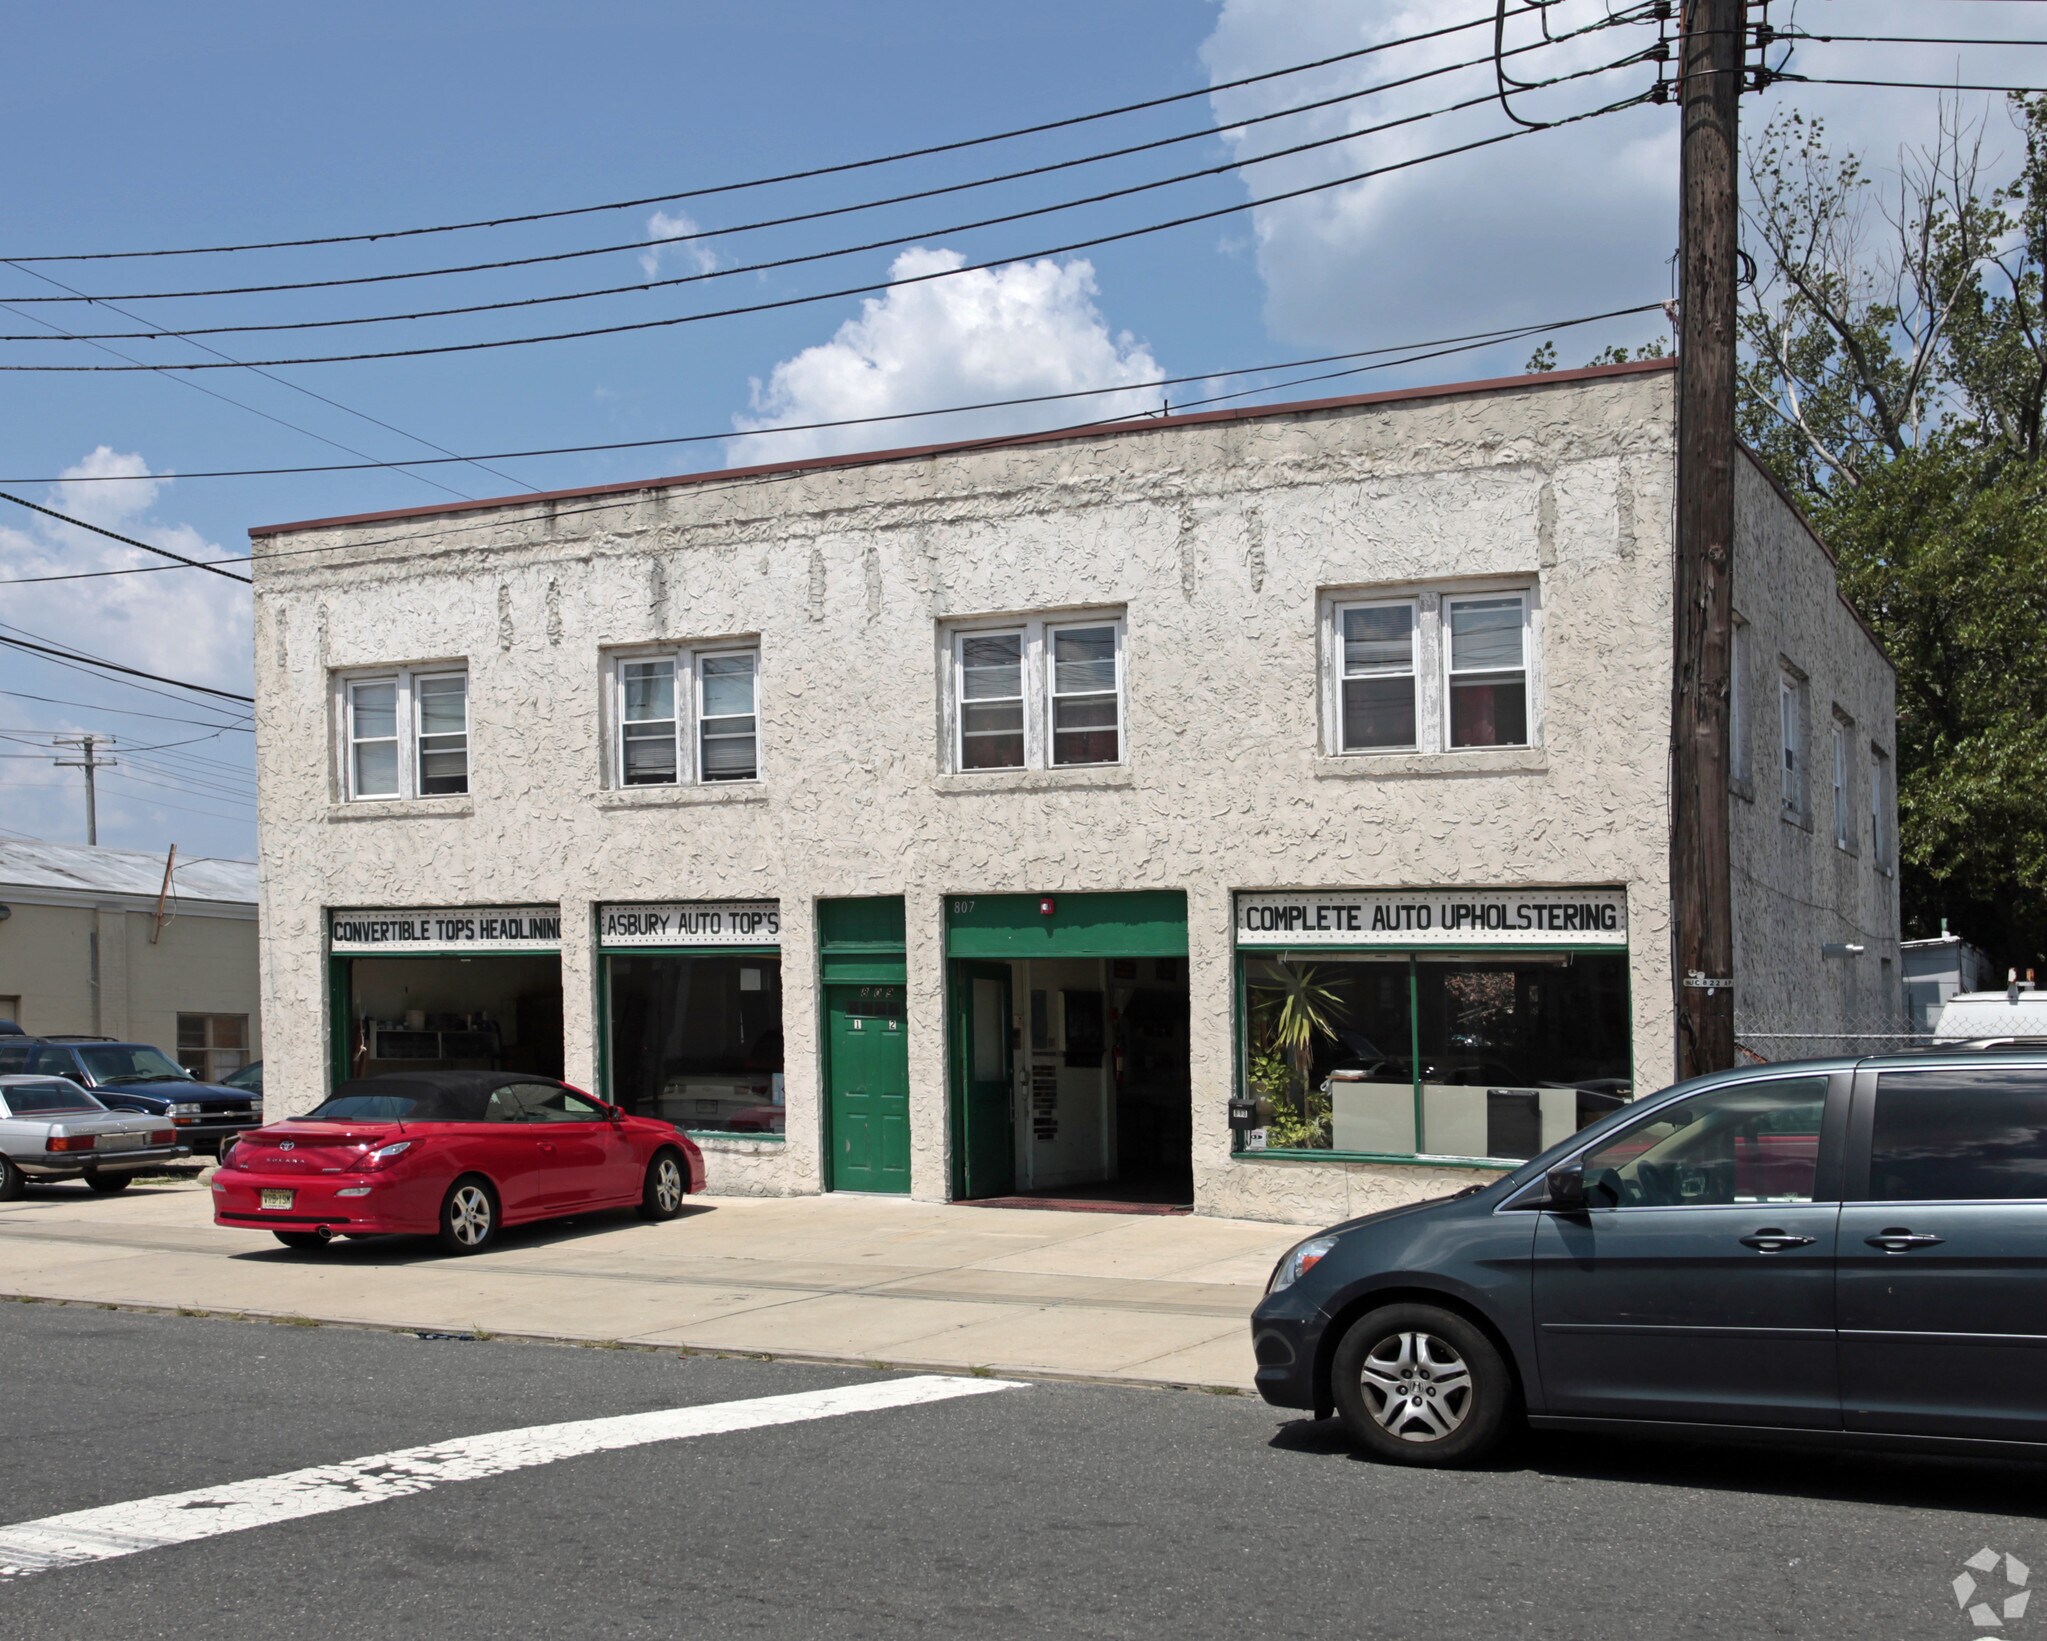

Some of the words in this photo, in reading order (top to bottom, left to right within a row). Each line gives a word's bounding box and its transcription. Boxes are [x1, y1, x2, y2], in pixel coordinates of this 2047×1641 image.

[954, 901, 975, 913] 807
[607, 914, 670, 936] ASBURY
[677, 913, 721, 934] AUTO
[729, 912, 779, 934] TOP'S
[1246, 905, 1362, 931] COMPLETE
[1371, 905, 1431, 930] AUTO
[1441, 904, 1617, 930] UPHOLSTERING
[333, 920, 431, 942] CONVERTIBLE
[436, 919, 475, 940] TOPS
[854, 1020, 861, 1029] 1
[889, 1020, 896, 1029] 2
